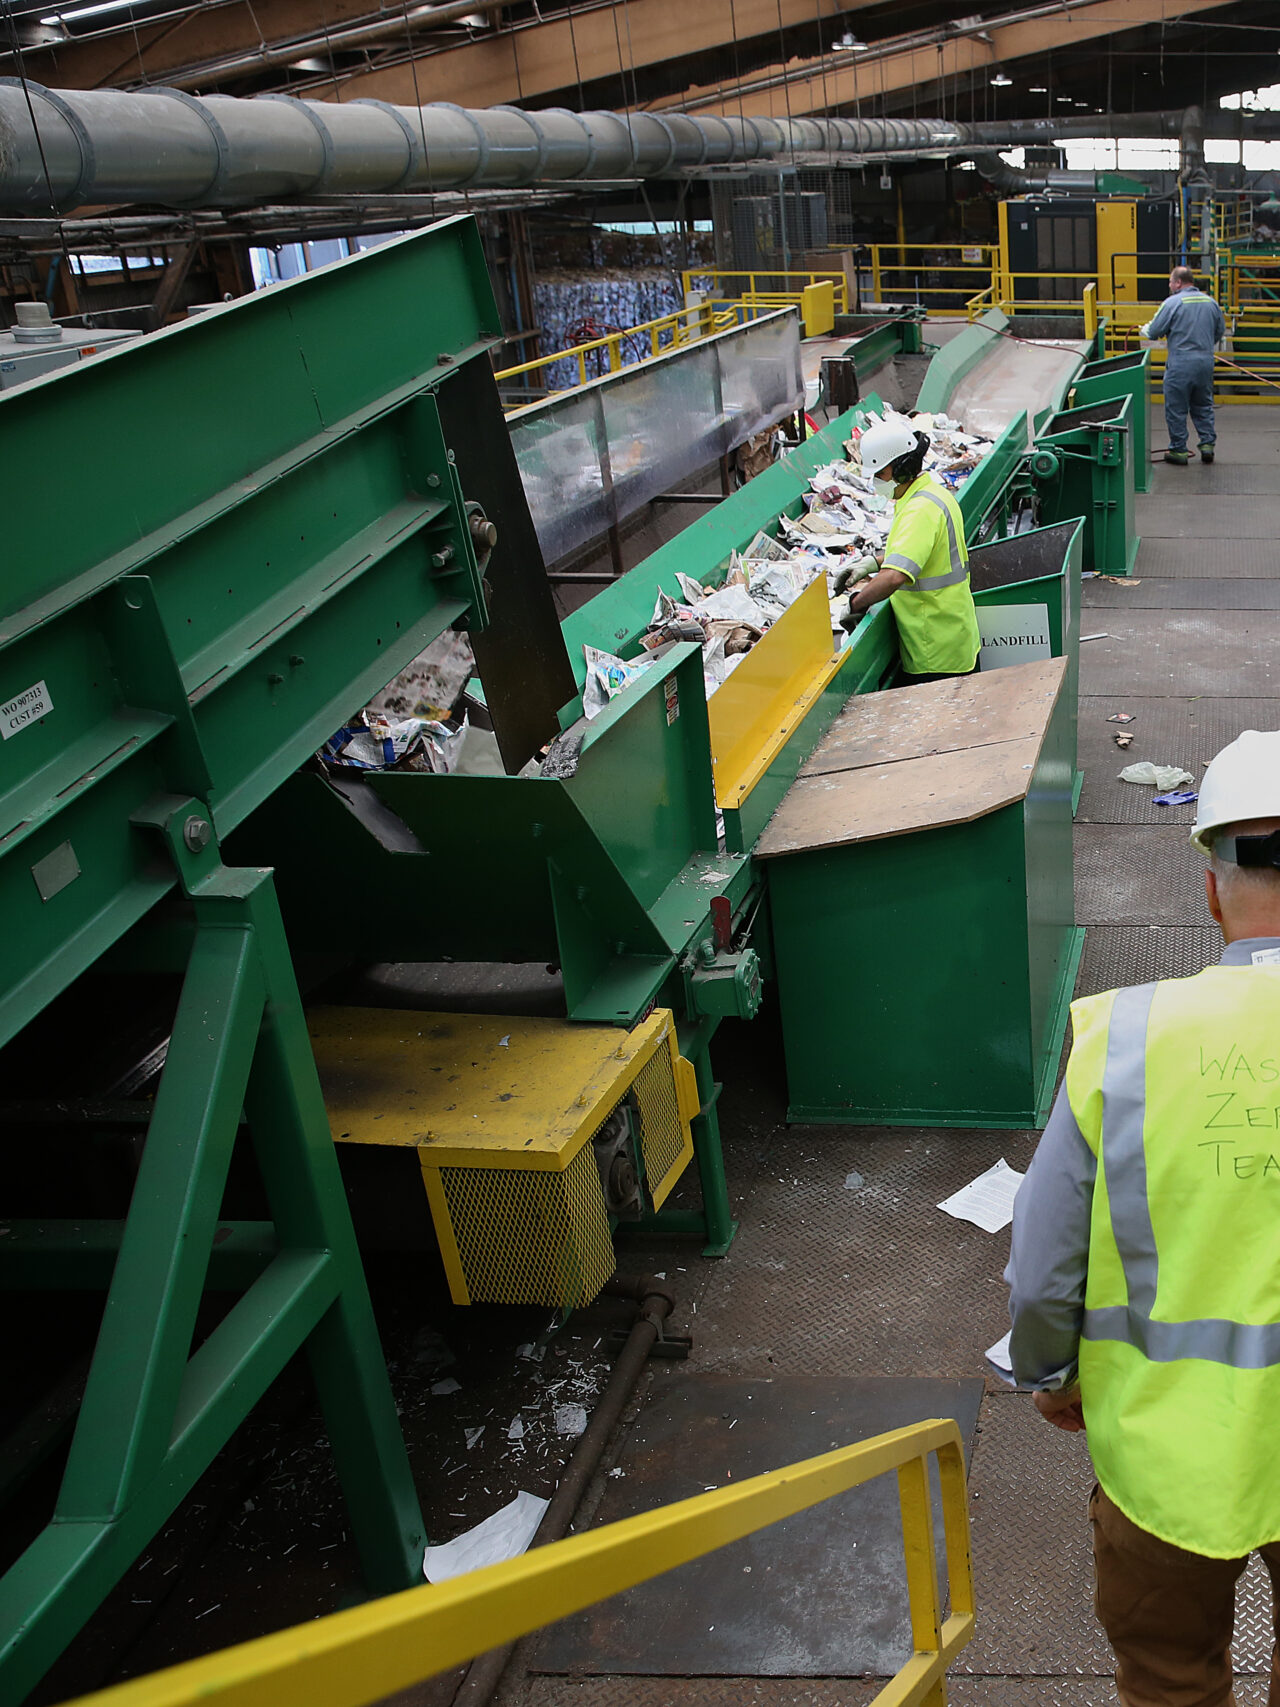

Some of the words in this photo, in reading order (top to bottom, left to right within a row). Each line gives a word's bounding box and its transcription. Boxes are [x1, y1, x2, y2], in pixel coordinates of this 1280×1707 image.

[982, 635, 1048, 647] LANDFILL
[1, 702, 17, 716] WO
[17, 687, 42, 708] 907313
[9, 709, 31, 729] CUST
[31, 701, 44, 715] #59
